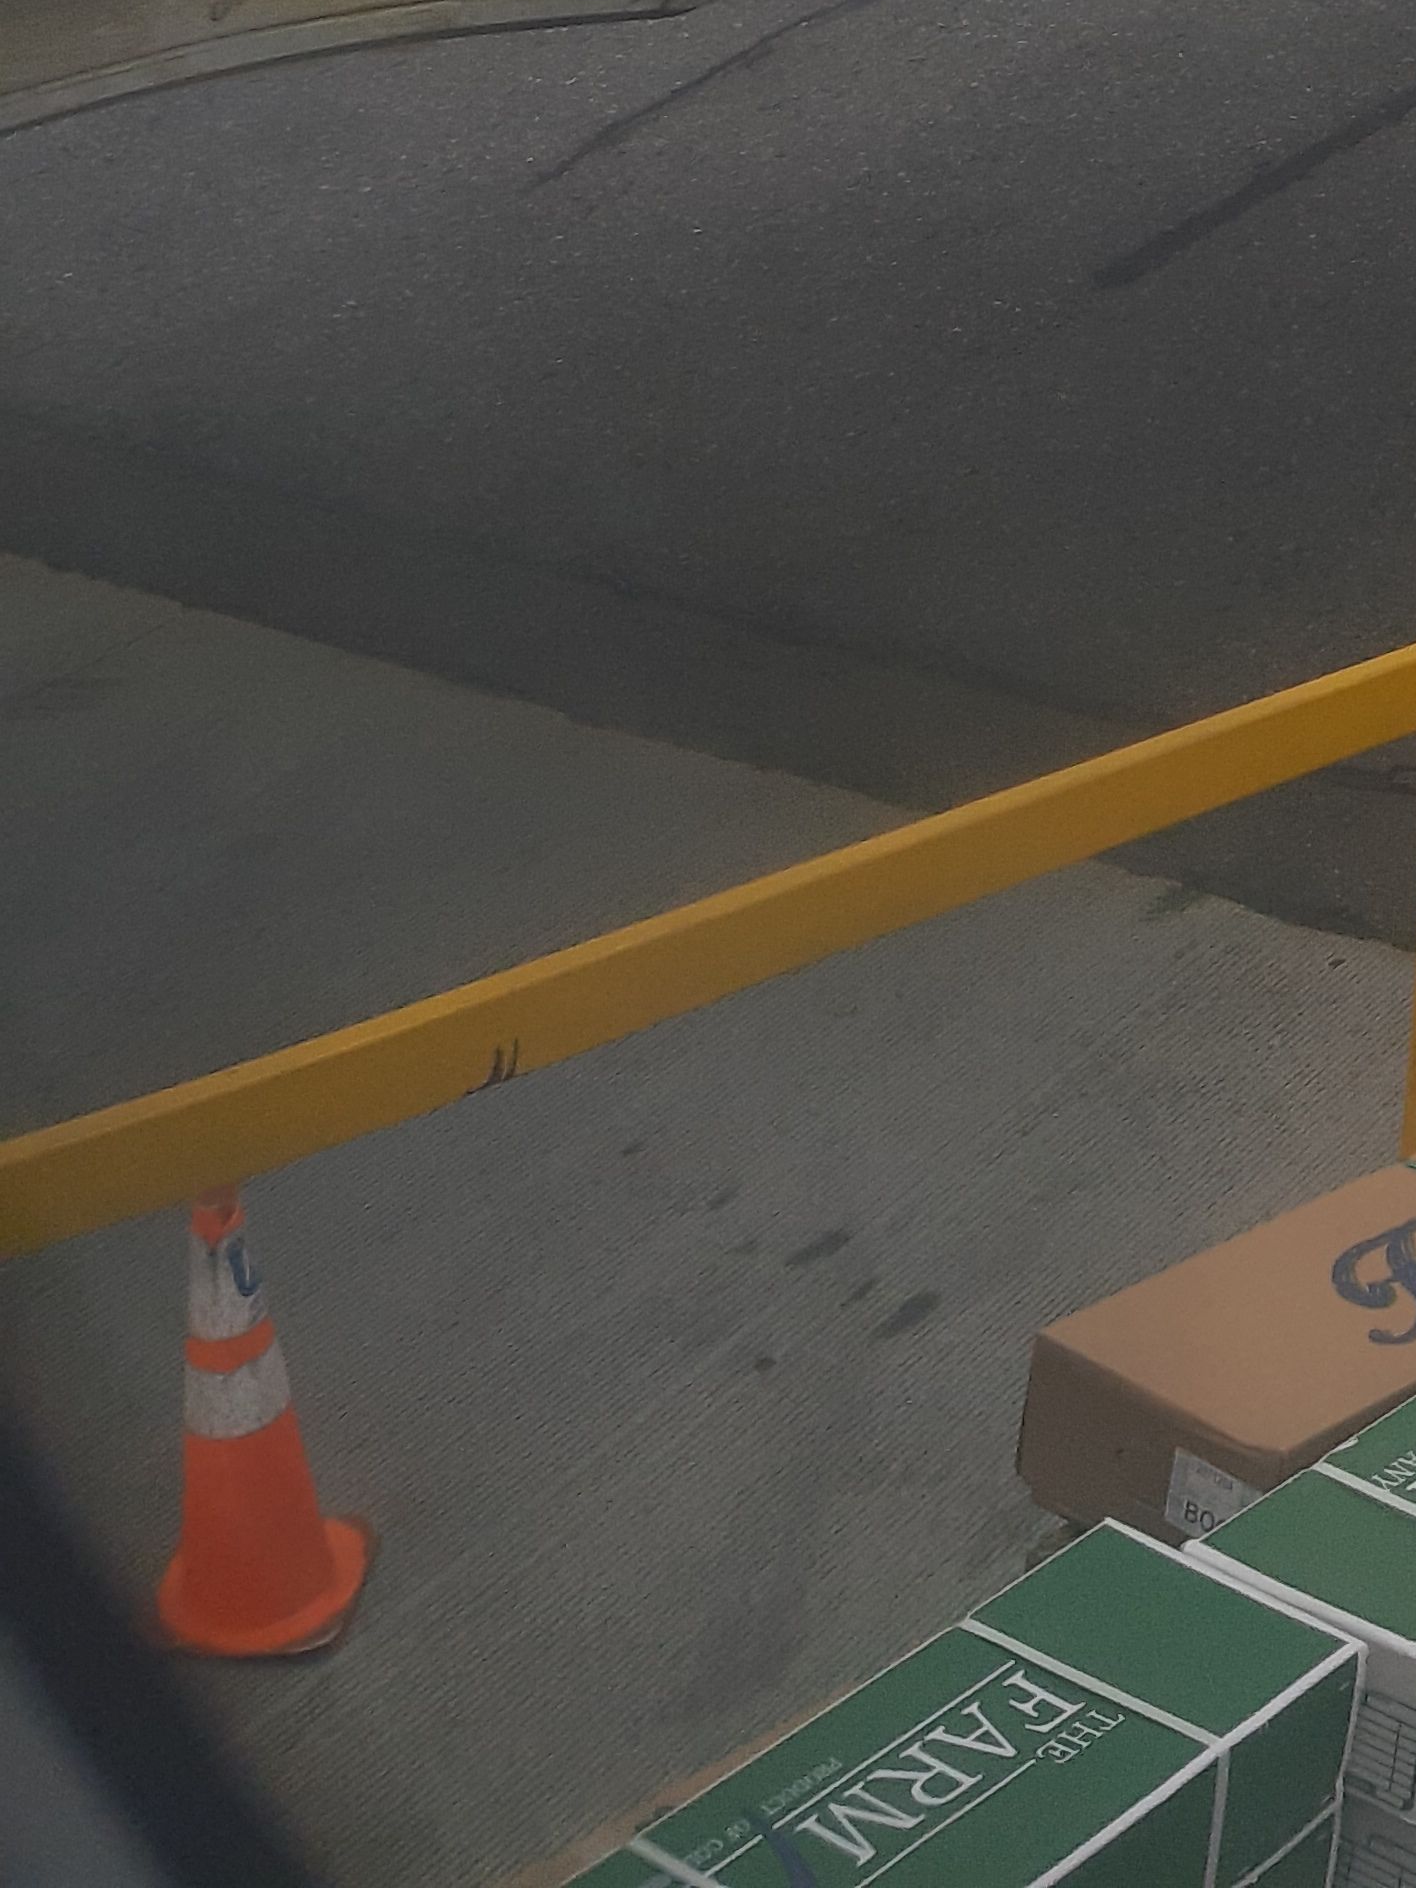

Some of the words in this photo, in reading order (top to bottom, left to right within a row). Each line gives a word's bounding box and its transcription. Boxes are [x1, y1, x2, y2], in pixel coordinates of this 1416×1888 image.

[1184, 1500, 1223, 1533] BO
[1039, 1708, 1126, 1765] THE
[794, 1669, 1087, 1868] FARM
